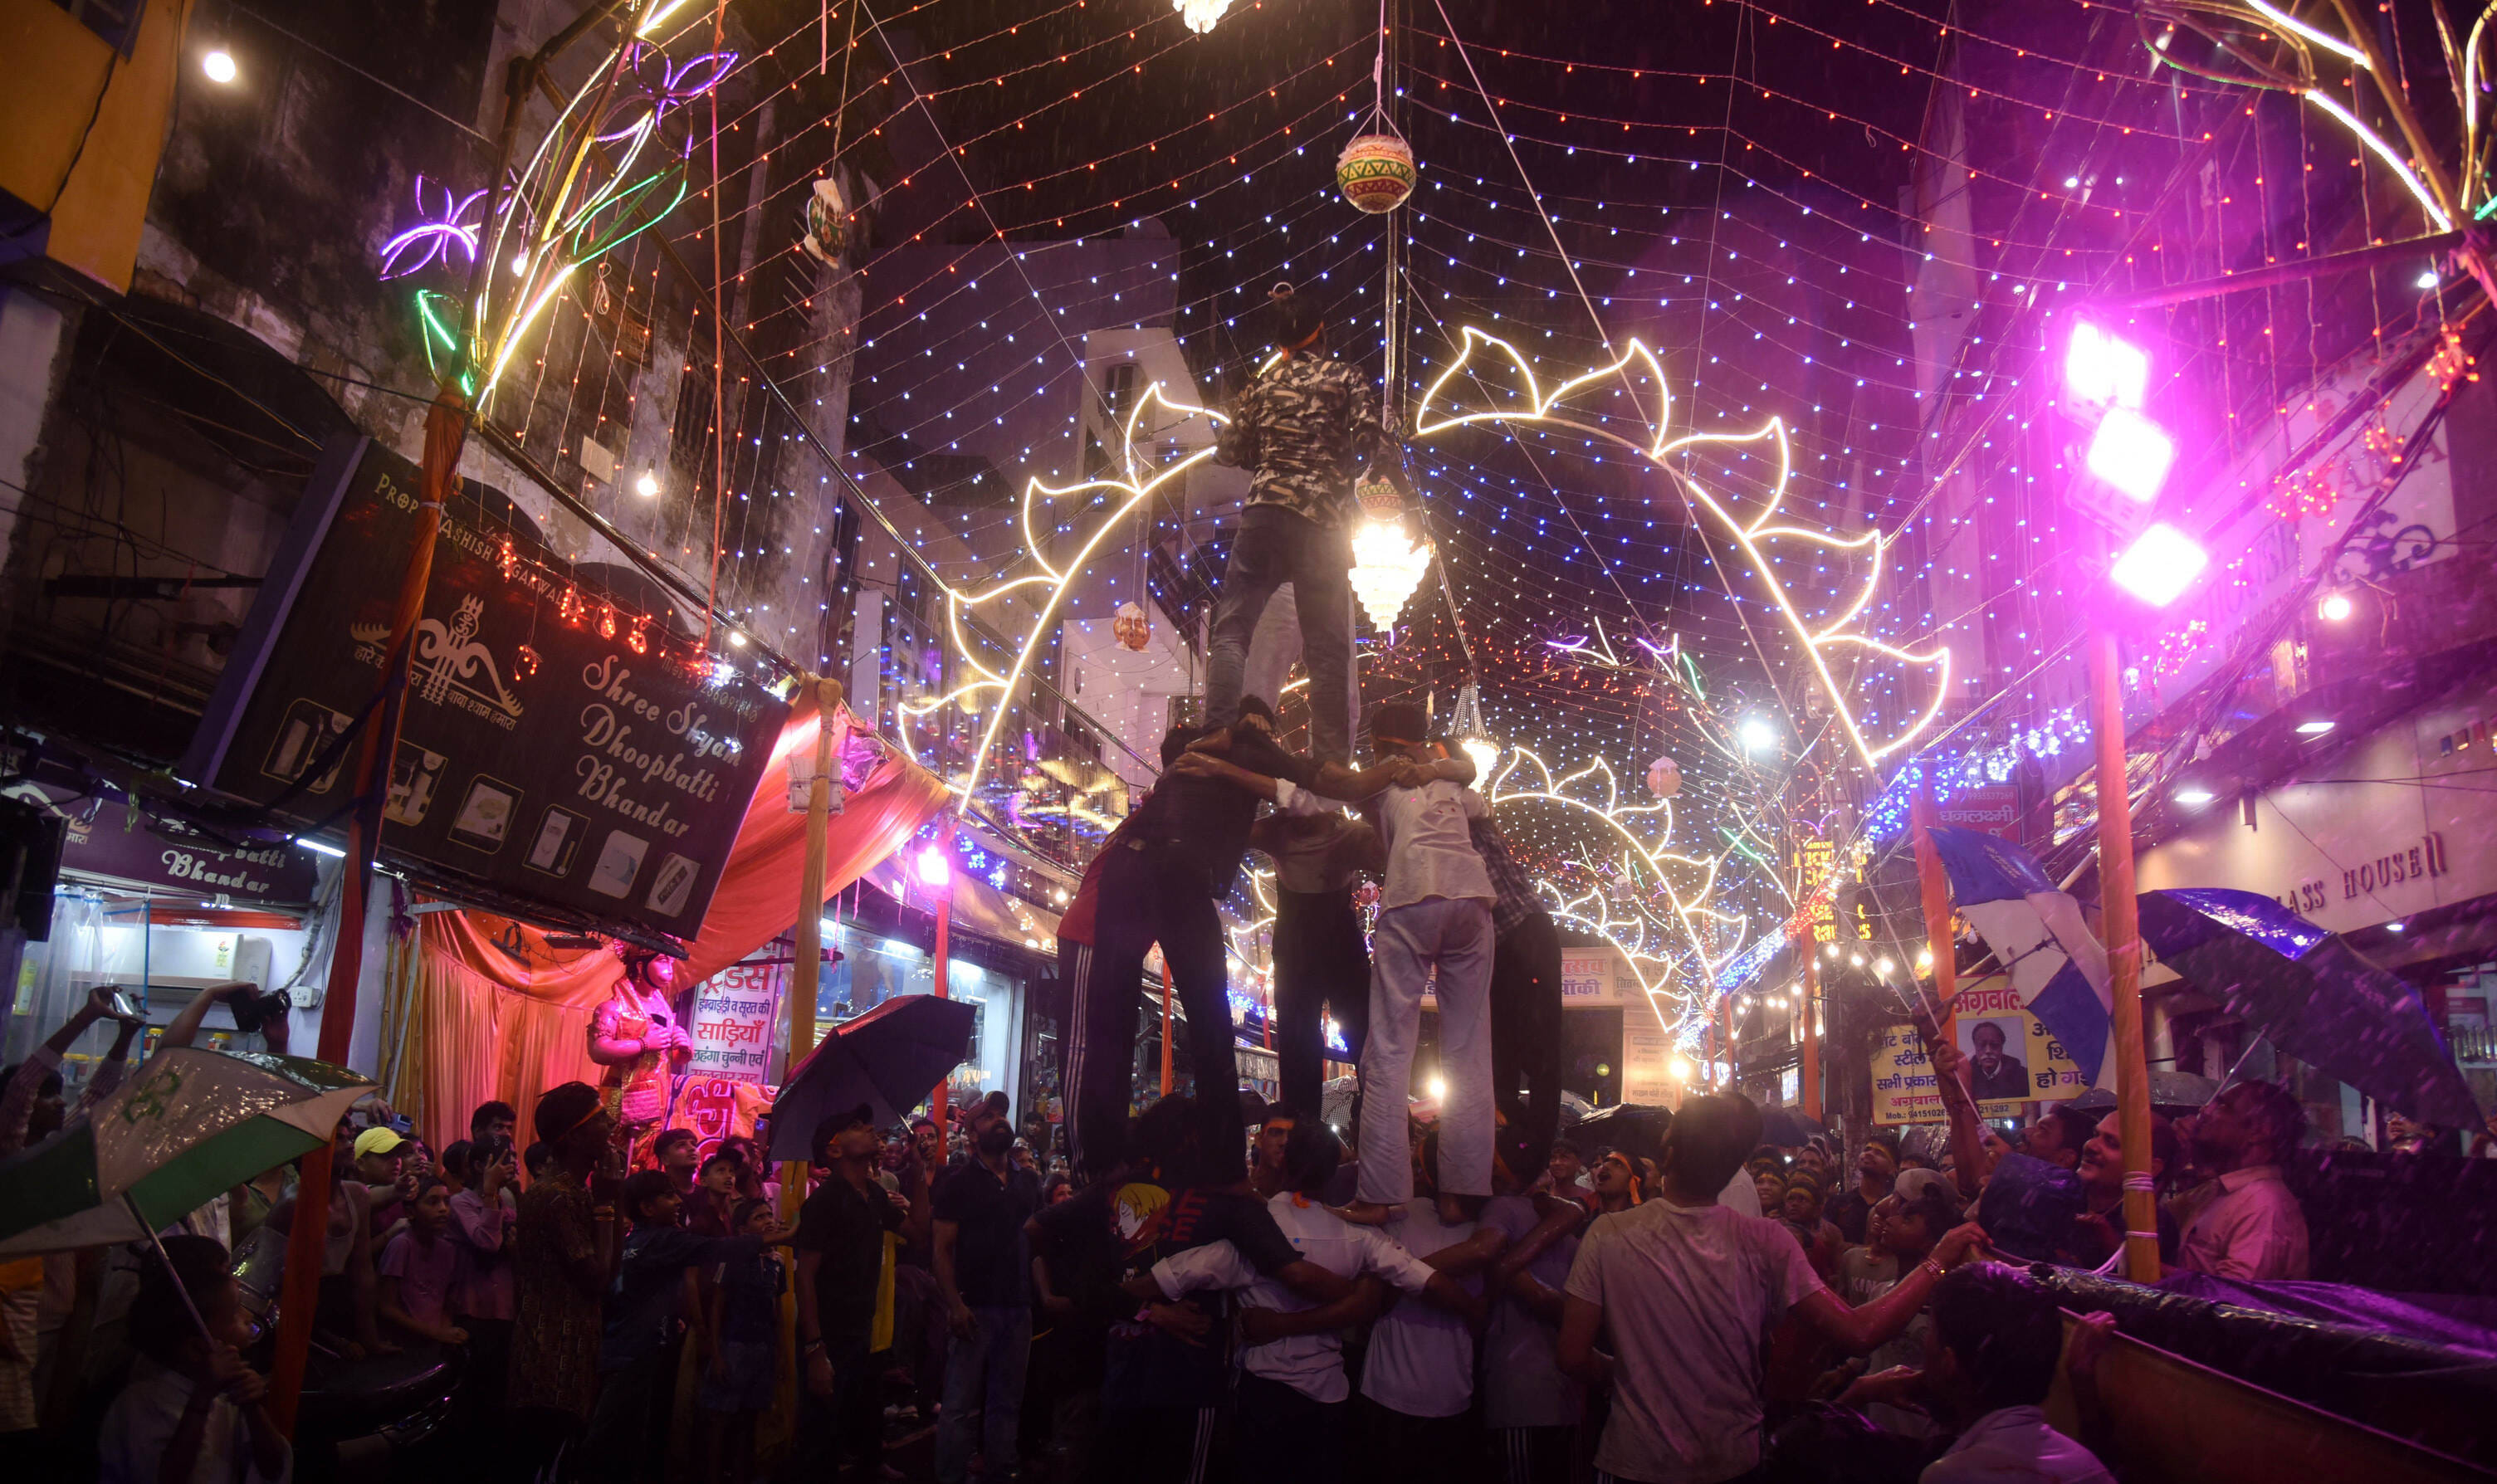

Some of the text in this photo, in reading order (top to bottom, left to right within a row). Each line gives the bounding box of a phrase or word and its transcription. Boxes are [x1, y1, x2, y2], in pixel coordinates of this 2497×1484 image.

[440, 517, 495, 562] ASHISH
[467, 699, 492, 720] श्याम
[490, 710, 518, 731] हमारा
[583, 654, 743, 768] Shree Shyam
[581, 703, 720, 803] Dhoopbatti
[576, 754, 691, 838] Bhandar
[161, 849, 271, 893] Bhandar
[2343, 847, 2423, 900] HOUSE
[731, 1002, 738, 1013] व
[739, 1002, 757, 1018] सूरत
[758, 998, 770, 1015] की
[697, 1018, 765, 1048] साड़ियाँ
[691, 1045, 765, 1069] लहंगा चुन्नी एवं
[1877, 1073, 1937, 1091] सभी प्रकार
[2035, 1067, 2057, 1089] हो
